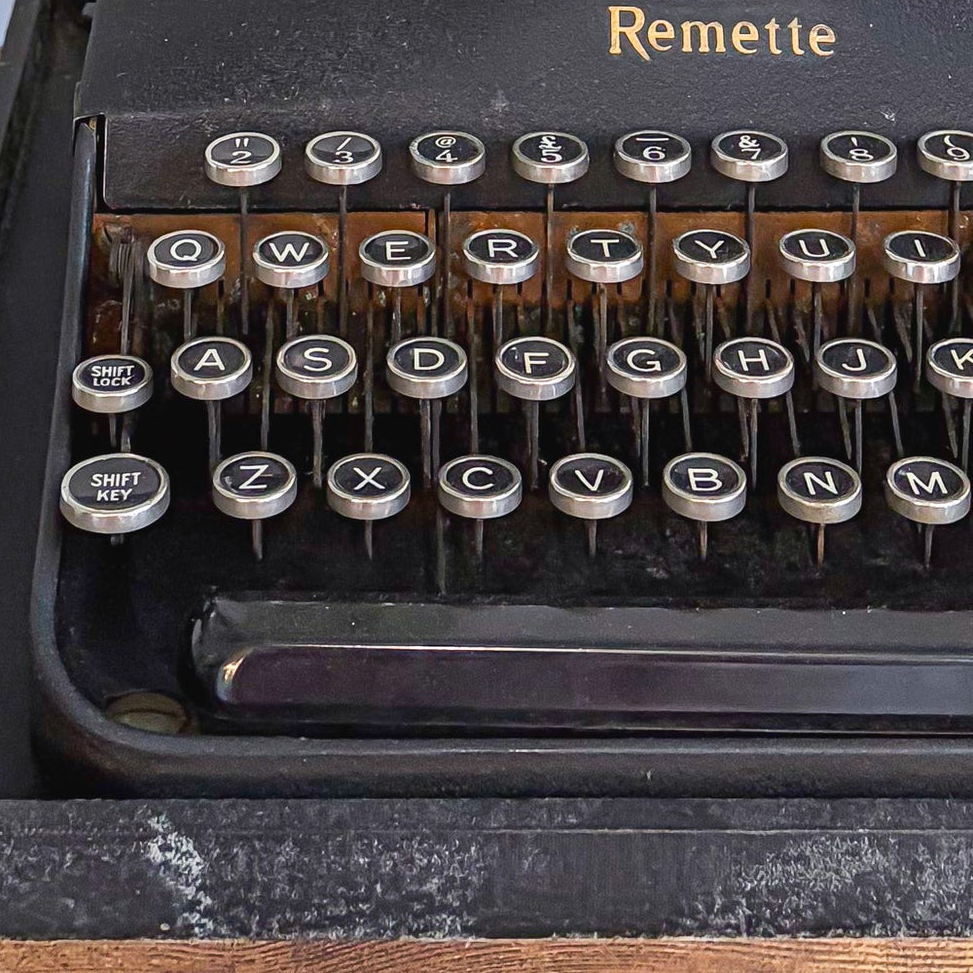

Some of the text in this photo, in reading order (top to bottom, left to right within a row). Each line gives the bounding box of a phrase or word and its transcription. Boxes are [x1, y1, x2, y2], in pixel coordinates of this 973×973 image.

[607, 5, 837, 62] Remette
[739, 135, 760, 148] &
[232, 151, 252, 164] 2
[335, 151, 353, 164] 3
[435, 149, 457, 162] 4
[540, 149, 563, 163] 5
[642, 146, 666, 161] 6
[740, 148, 763, 161] 7
[849, 148, 875, 162] 8
[946, 147, 971, 162] 9
[170, 239, 201, 260] Q
[269, 242, 310, 262] W
[385, 240, 411, 260] E
[487, 239, 518, 258] R
[590, 240, 620, 257] T
[694, 240, 724, 258] Y
[799, 239, 830, 257] U
[914, 240, 926, 257] I
[194, 348, 226, 371] A
[303, 348, 332, 371] S
[414, 348, 445, 370] D
[524, 352, 549, 373] F
[626, 349, 661, 371] G
[738, 349, 769, 372] H
[842, 349, 866, 371] J
[950, 349, 973, 371] K
[91, 365, 134, 377] SHIFT
[93, 377, 131, 387] LOCK
[91, 473, 141, 487] SHIFT
[239, 465, 272, 489] Z
[353, 467, 384, 489] X
[462, 467, 493, 489] C
[575, 470, 604, 491] V
[689, 469, 721, 491] B
[804, 472, 838, 494] N
[907, 472, 947, 494] M
[97, 488, 132, 502] KEY
